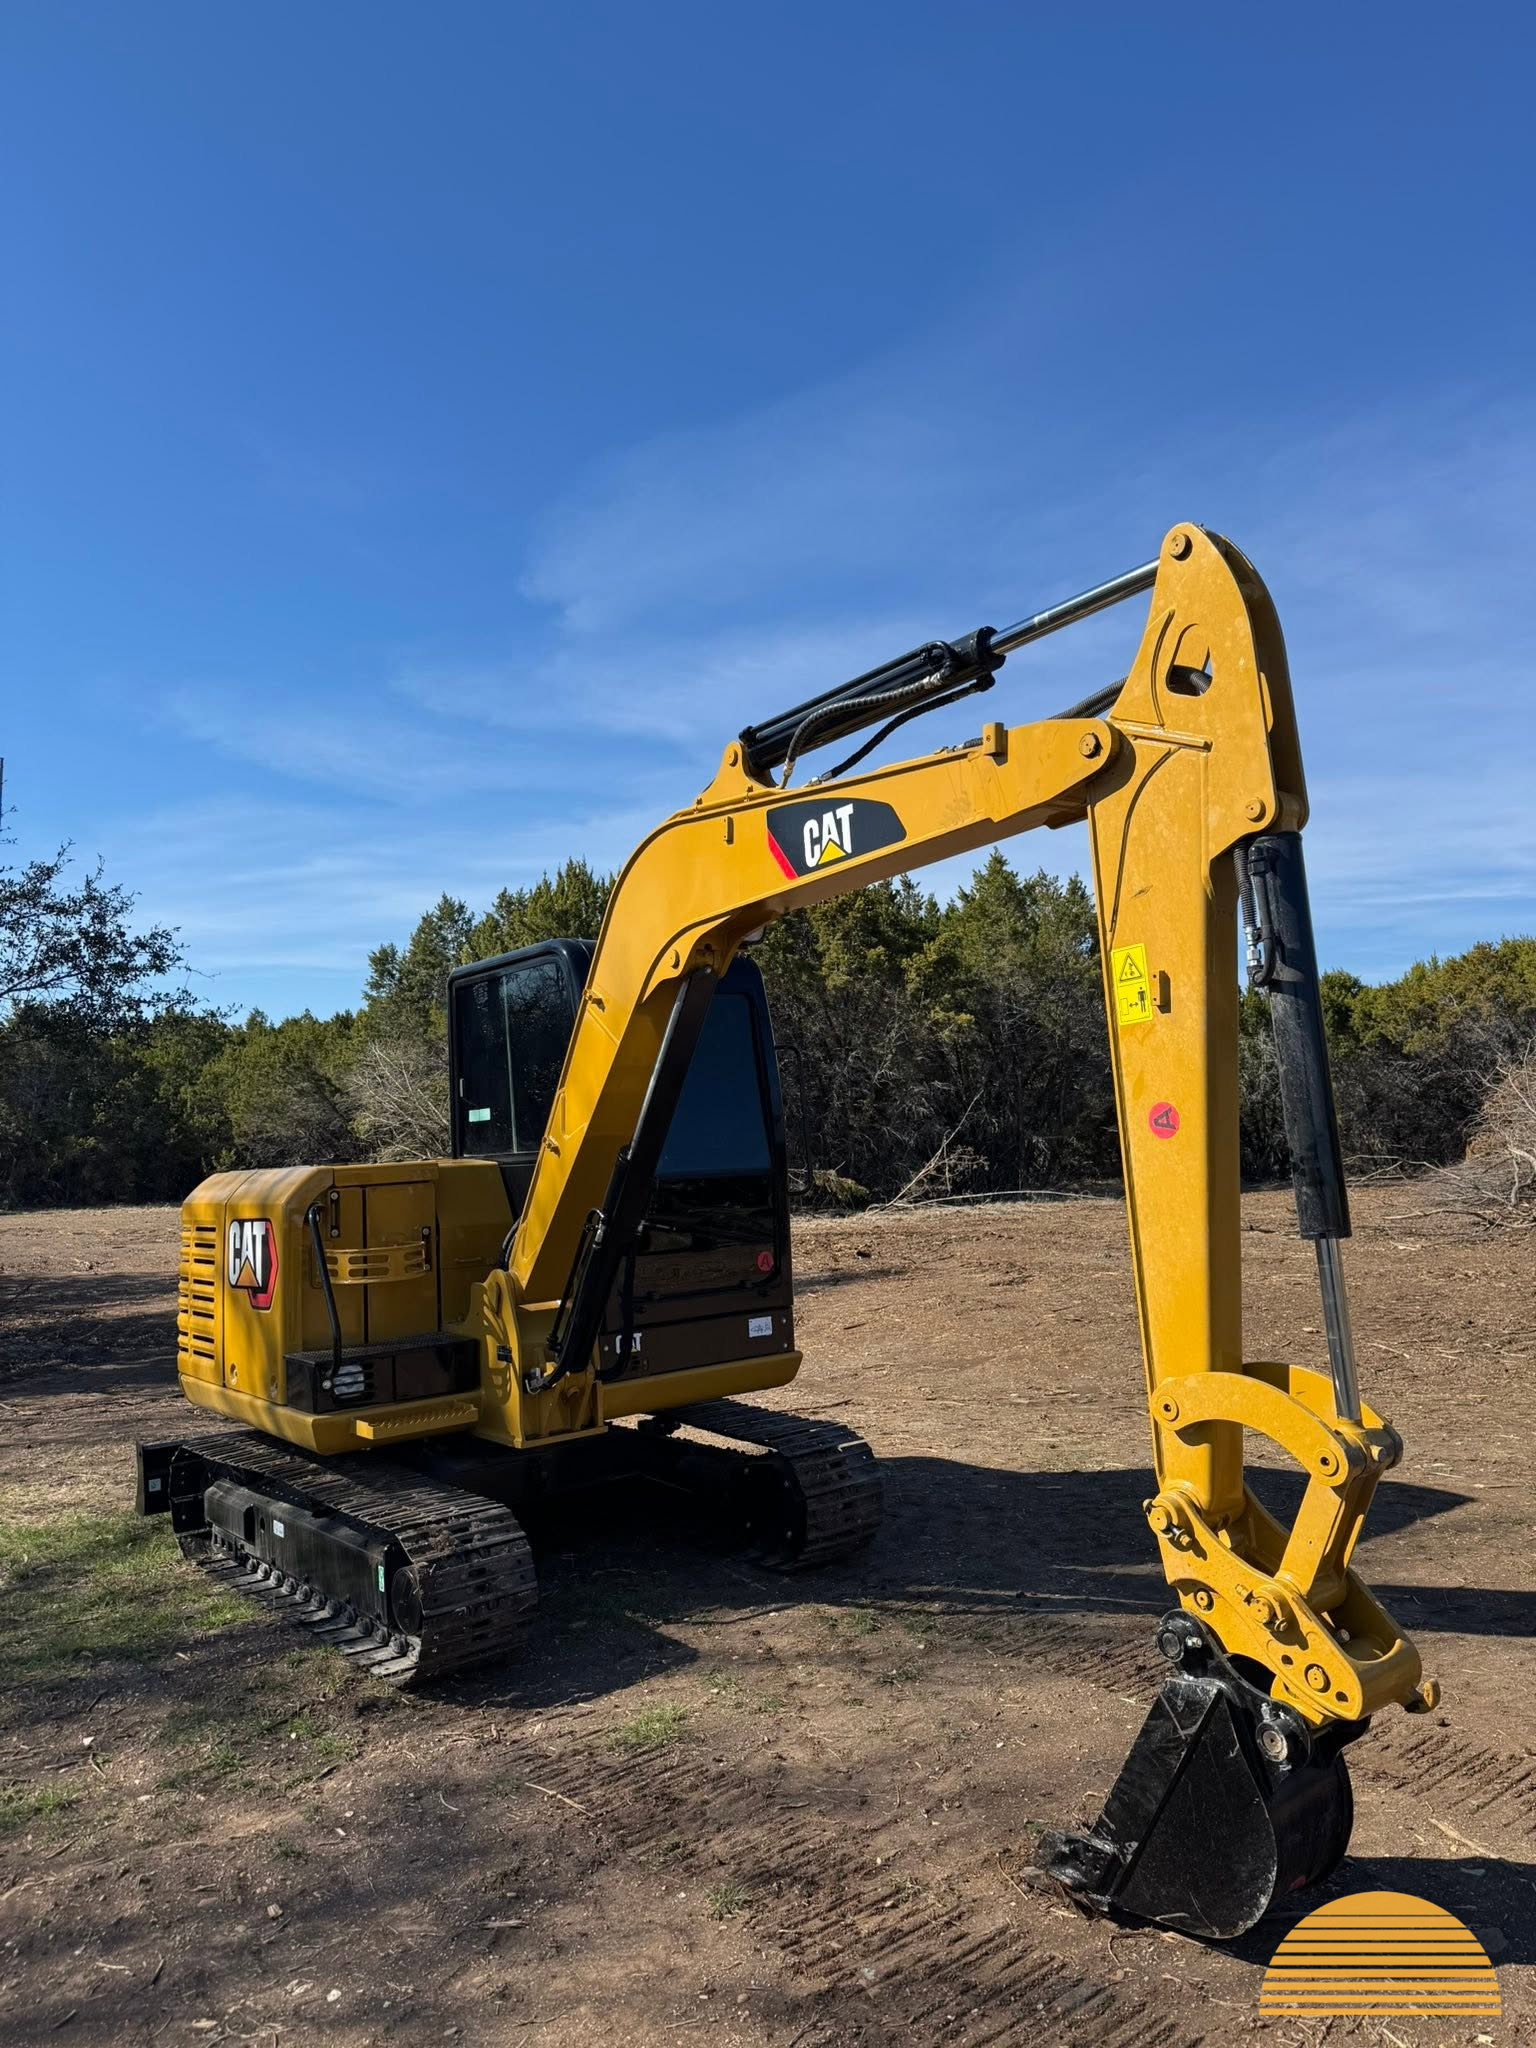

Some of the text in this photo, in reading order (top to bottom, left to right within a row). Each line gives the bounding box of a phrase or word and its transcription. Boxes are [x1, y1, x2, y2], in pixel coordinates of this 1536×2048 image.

[803, 803, 854, 868] CAT
[228, 1221, 266, 1288] CAT
[615, 1332, 642, 1355] CT
